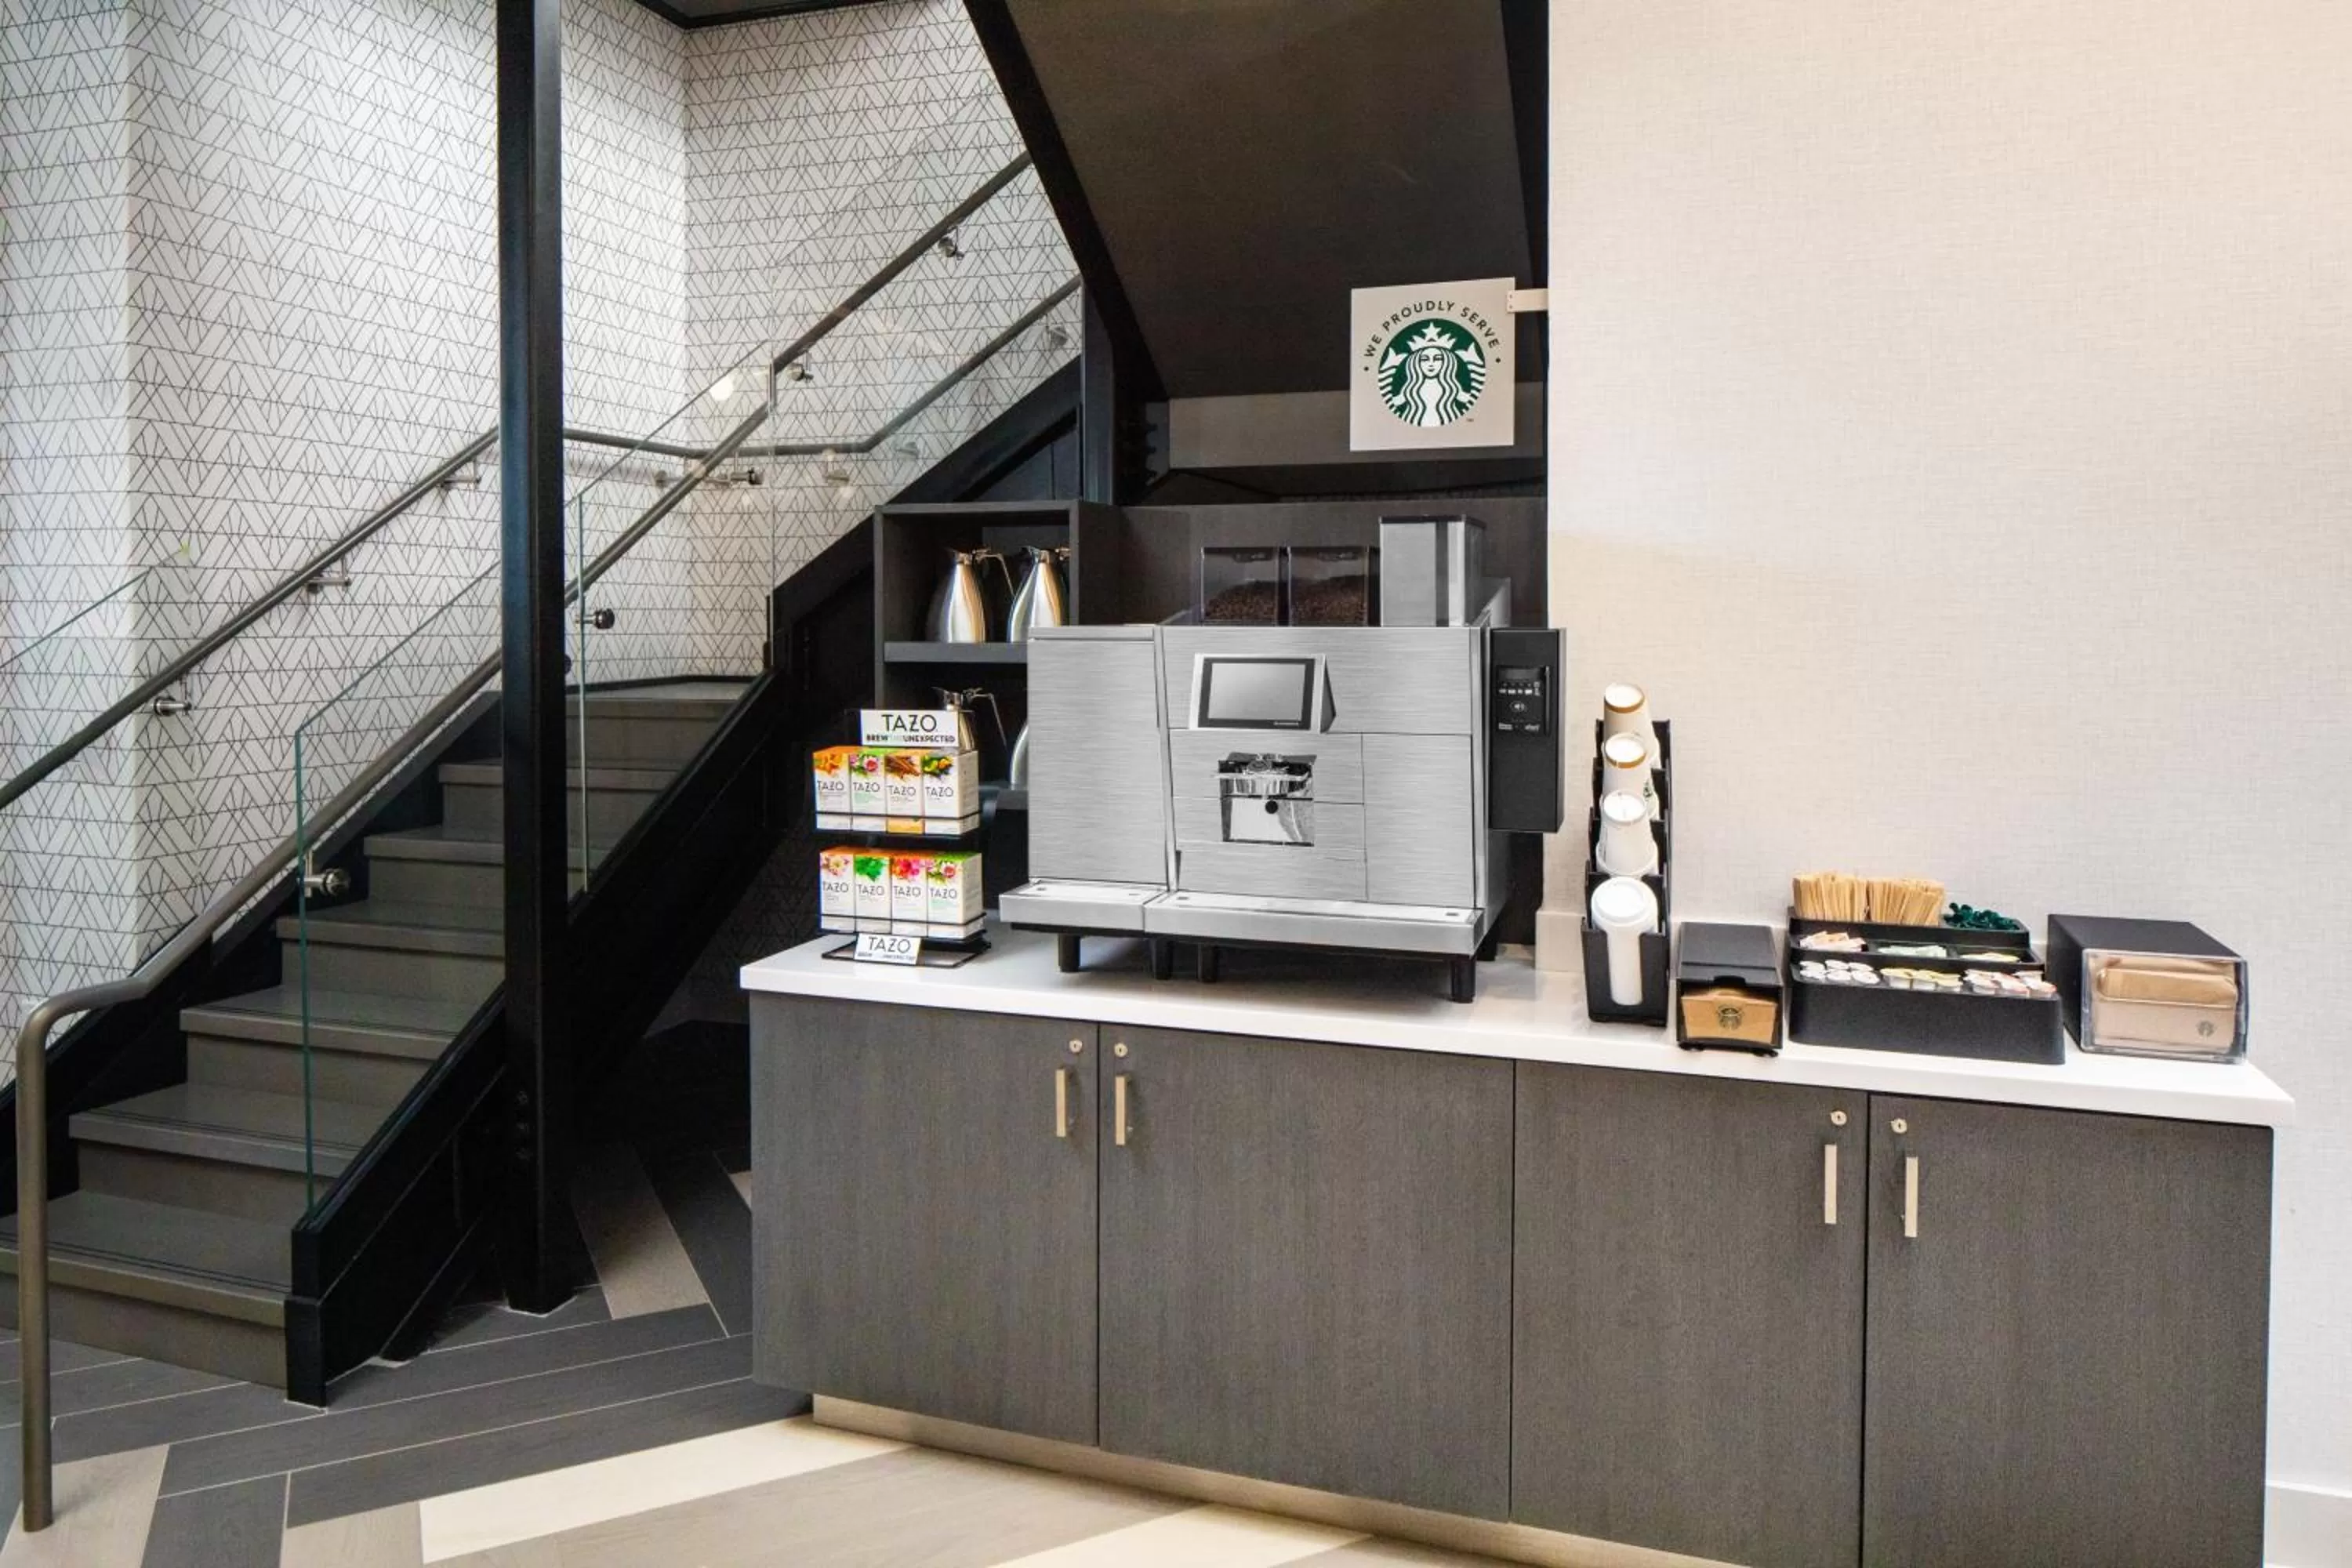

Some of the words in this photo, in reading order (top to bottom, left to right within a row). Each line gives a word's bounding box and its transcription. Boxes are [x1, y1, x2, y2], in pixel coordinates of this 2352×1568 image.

[1364, 334, 1383, 358] WE
[1383, 300, 1455, 332] PROUDLY
[1460, 307, 1500, 348] SERVE
[881, 714, 937, 732] TAZO
[817, 780, 844, 791] TAZO
[853, 782, 880, 793] TAZO
[887, 785, 916, 797] TAZO
[925, 786, 954, 797] TAZO
[823, 881, 849, 893] TAZO
[856, 884, 884, 896] TAZO
[893, 885, 921, 898] TAZO
[930, 887, 957, 899] TAZO
[868, 936, 911, 954] TAZO
